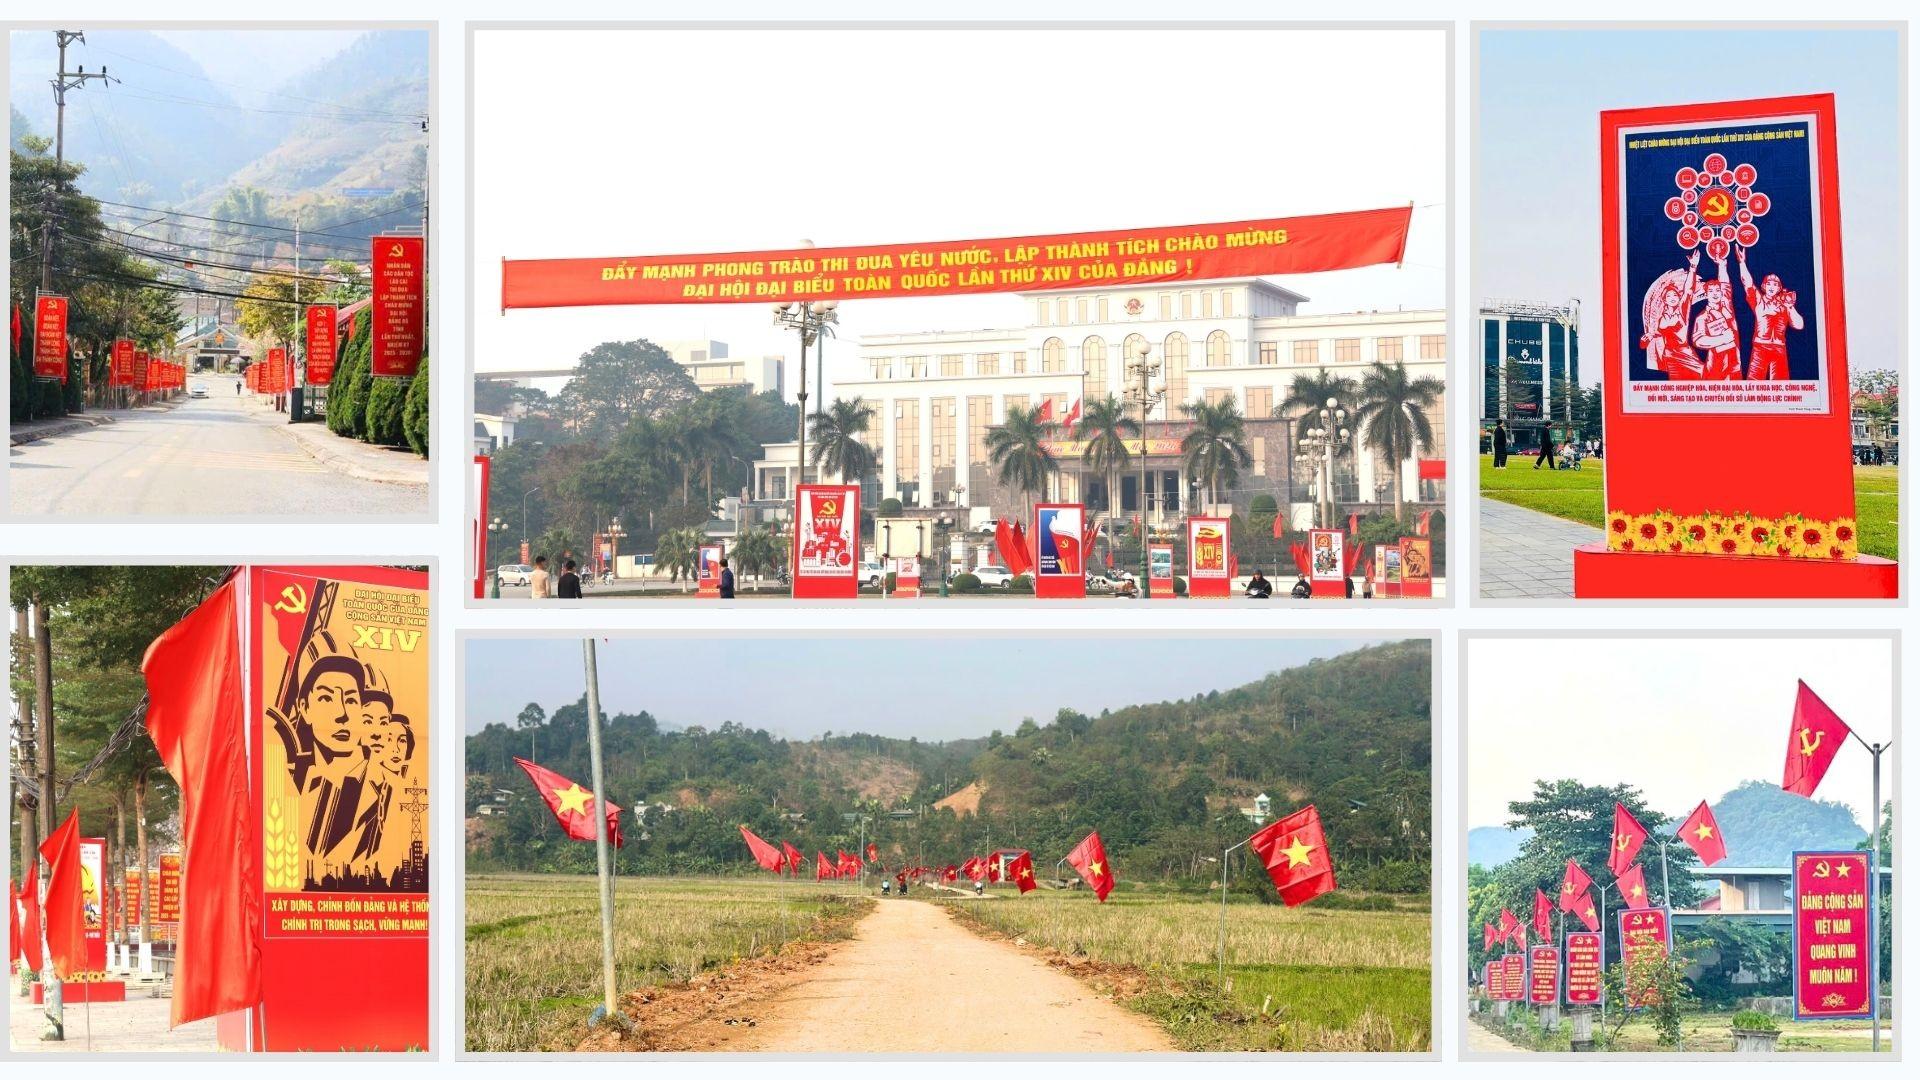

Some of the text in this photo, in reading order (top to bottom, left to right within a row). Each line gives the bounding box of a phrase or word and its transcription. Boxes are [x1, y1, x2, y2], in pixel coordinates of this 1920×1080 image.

[602, 260, 637, 280] ĐẨY
[642, 265, 696, 281] MẠNH
[702, 261, 764, 277] PHONG
[770, 257, 814, 275] TRÀO
[821, 257, 849, 272] THI
[856, 254, 893, 271] ĐUA
[900, 251, 934, 268] YÊU
[1005, 246, 1040, 264] LẬP
[1045, 241, 1109, 260] THÀNH
[1116, 238, 1160, 255] TÍCH
[1166, 233, 1218, 252] CHÀO
[1226, 227, 1287, 248] MỪNG
[683, 258, 1192, 299] ĐẠI HỘI ĐẠI BIỂU TOÀN QUỐC LẦN THỨ XIV CỦA ĐẢNG !
[815, 518, 841, 528] XIV
[355, 589, 420, 604] ĐẠI HỘI ĐẠI BIỂU
[343, 599, 429, 616] TOÀN QUỐC CỦA ĐẢNG
[346, 610, 426, 626] CỘNG SẢN VIỆT NAM
[352, 624, 422, 652] XIV
[272, 898, 288, 912] XÂY
[290, 900, 315, 914] DỰNG,
[318, 896, 343, 912] CHỈNH
[345, 896, 362, 912] ĐỐN
[364, 896, 385, 912] ĐẢNG
[387, 898, 397, 912] VÀ
[401, 898, 410, 915] HỆ
[1802, 890, 1863, 912] ĐẢNG CỘNG SẢN
[282, 916, 428, 933] CHÍNH TRỊ TRONG SẠCH, VỮNG MẠNH!
[1815, 919, 1851, 937] VIỆT NAM
[1810, 944, 1856, 960] QUANG VINH
[1810, 966, 1833, 984] MUÔN
[1834, 967, 1853, 984] NĂM
